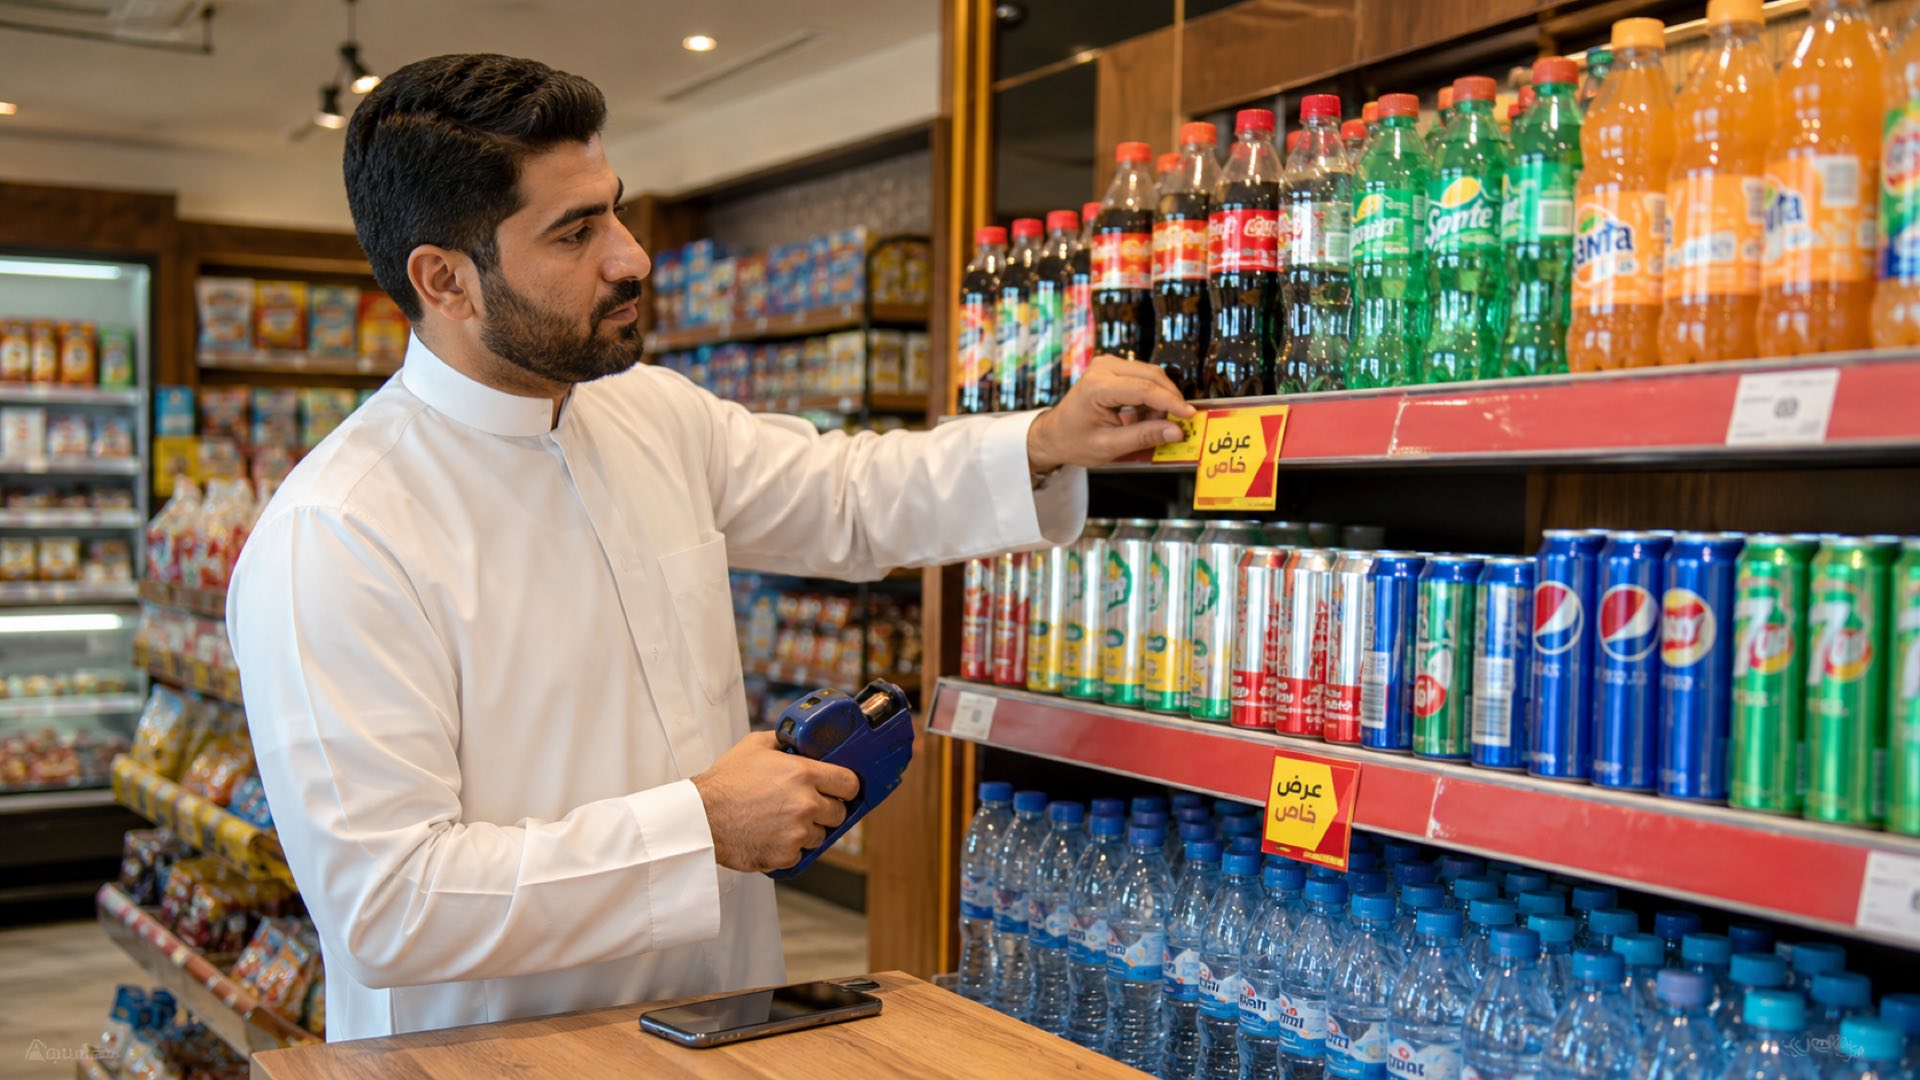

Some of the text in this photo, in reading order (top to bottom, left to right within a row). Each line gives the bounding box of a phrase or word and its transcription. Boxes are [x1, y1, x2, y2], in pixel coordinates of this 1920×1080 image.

[1574, 220, 1633, 266] anta
[1208, 431, 1251, 455] عرض
[1206, 456, 1246, 479] خاص
[1277, 775, 1322, 800] عرض
[1275, 803, 1317, 824] خاص
